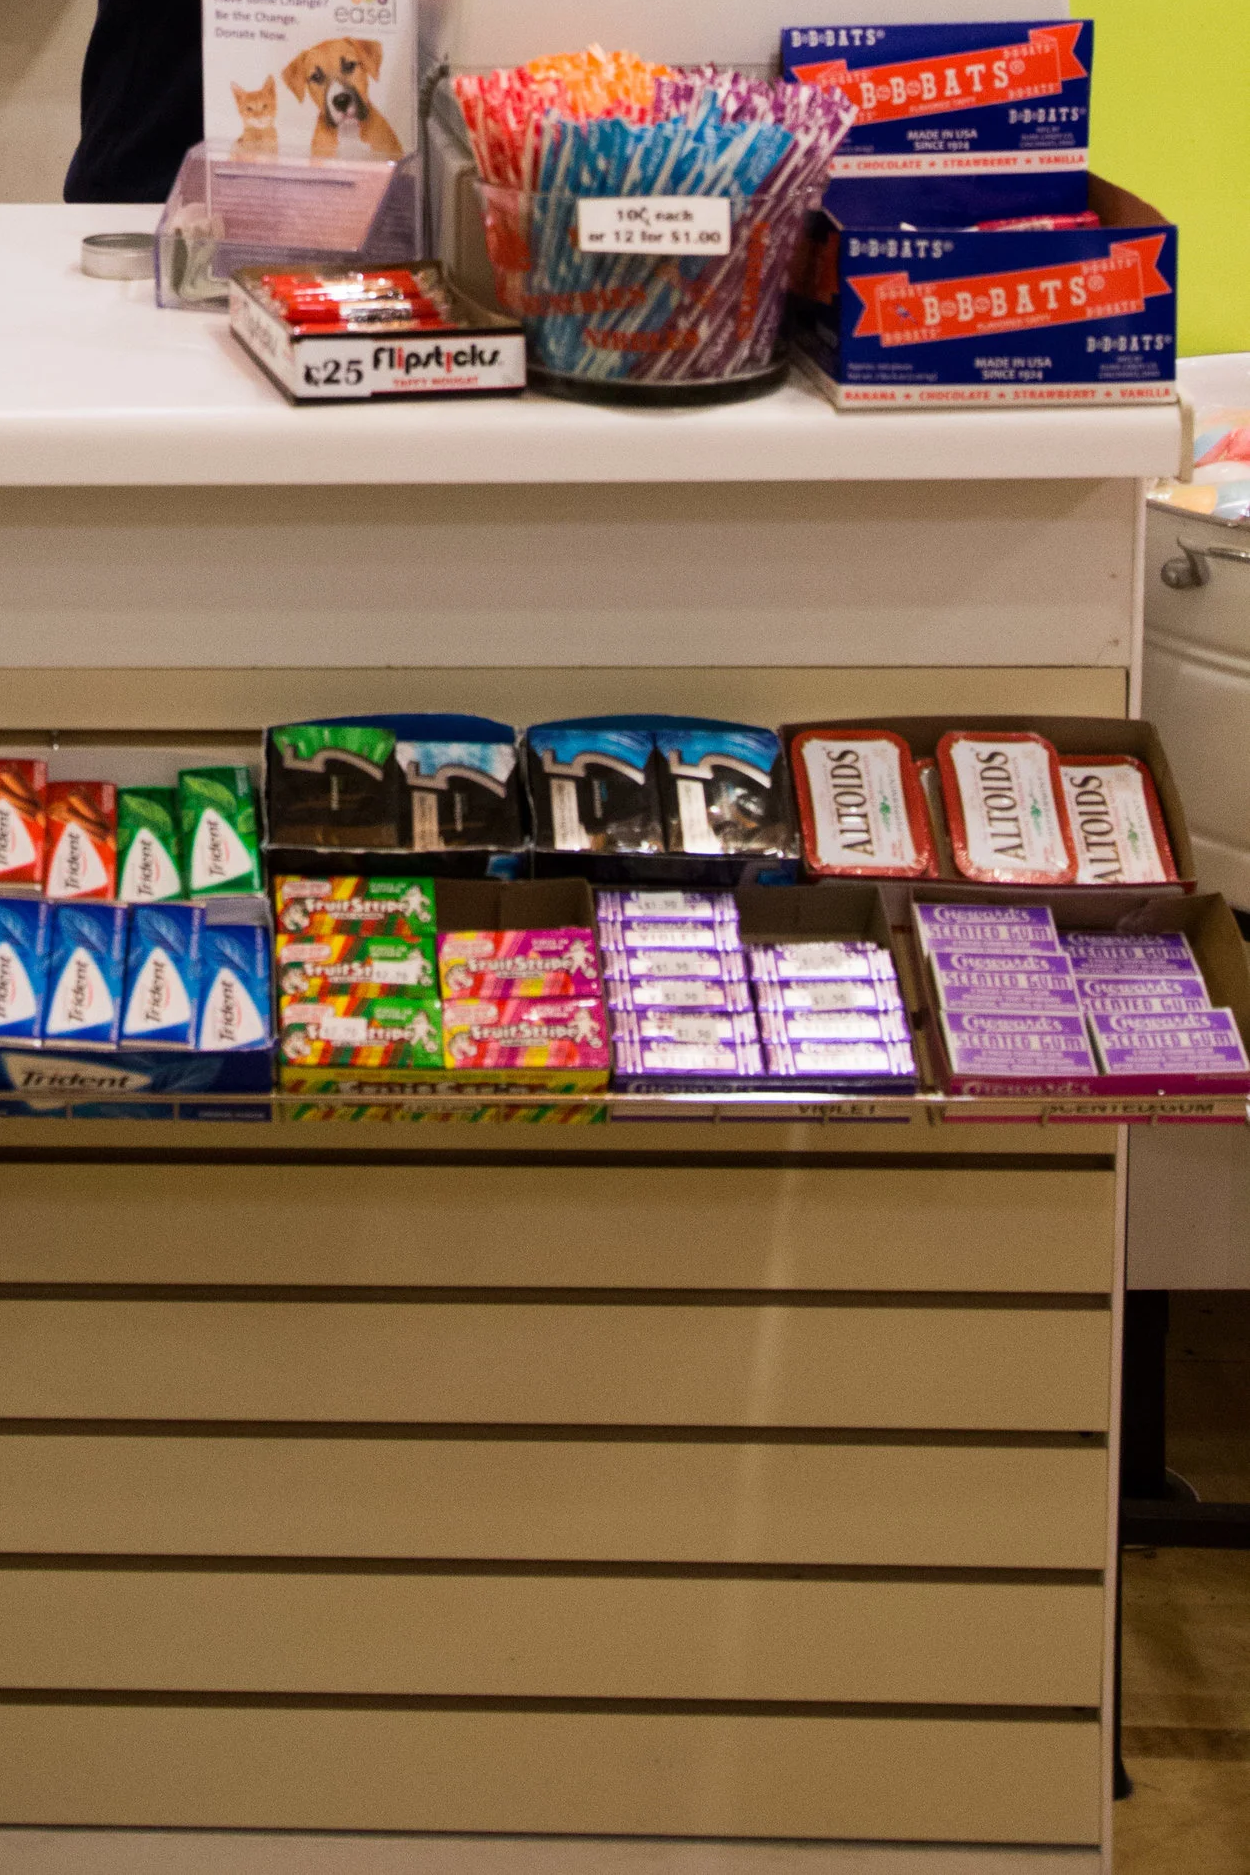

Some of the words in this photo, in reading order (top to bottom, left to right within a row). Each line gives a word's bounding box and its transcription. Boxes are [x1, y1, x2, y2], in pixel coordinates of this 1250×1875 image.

[214, 10, 228, 20] Be
[232, 9, 251, 21] the
[334, 0, 397, 25] easel
[215, 27, 255, 39] Donate
[906, 129, 939, 141] MADE
[941, 129, 952, 140] IN
[953, 128, 978, 140] USA
[914, 141, 945, 152] SINCE
[856, 159, 922, 171] CHOCOLATE
[942, 157, 1018, 168] STRAWBERRY
[1038, 154, 1085, 166] VANILLA
[655, 209, 693, 222] each
[588, 232, 605, 243] or
[614, 231, 634, 243] 12
[641, 230, 664, 244] for
[671, 230, 721, 244] $1.00
[372, 343, 501, 375] Flipsticks
[974, 357, 1008, 369] MADE
[1011, 357, 1024, 369] IN
[1025, 357, 1052, 368] USA
[982, 369, 1017, 381] SINCE
[844, 391, 897, 402] BANANA
[919, 390, 990, 401] CHOCOLATE
[1013, 389, 1097, 400] STRAWBERRY
[1119, 388, 1171, 399] VANILLA
[827, 749, 875, 858] ALTOIDS
[975, 750, 1027, 862] ALTOIDS
[1070, 775, 1124, 884] ALTOIDS
[210, 818, 228, 877] Trident
[64, 830, 80, 890] Trident
[138, 838, 153, 897] Trident
[930, 926, 1000, 940] SCENTED
[1008, 927, 1049, 941] GUM
[146, 958, 166, 1022] Trident
[944, 973, 1018, 987] SCENTED
[1027, 975, 1069, 990] GUM
[68, 959, 89, 1023] Trident
[219, 979, 236, 1042] Trident
[1161, 998, 1201, 1011] GUM
[956, 1033, 1030, 1049] SCENTED
[1039, 1035, 1083, 1050] GUM
[1104, 1033, 1180, 1048] SCENTED
[1188, 1033, 1230, 1047] GUM
[21, 1069, 131, 1089] Trident
